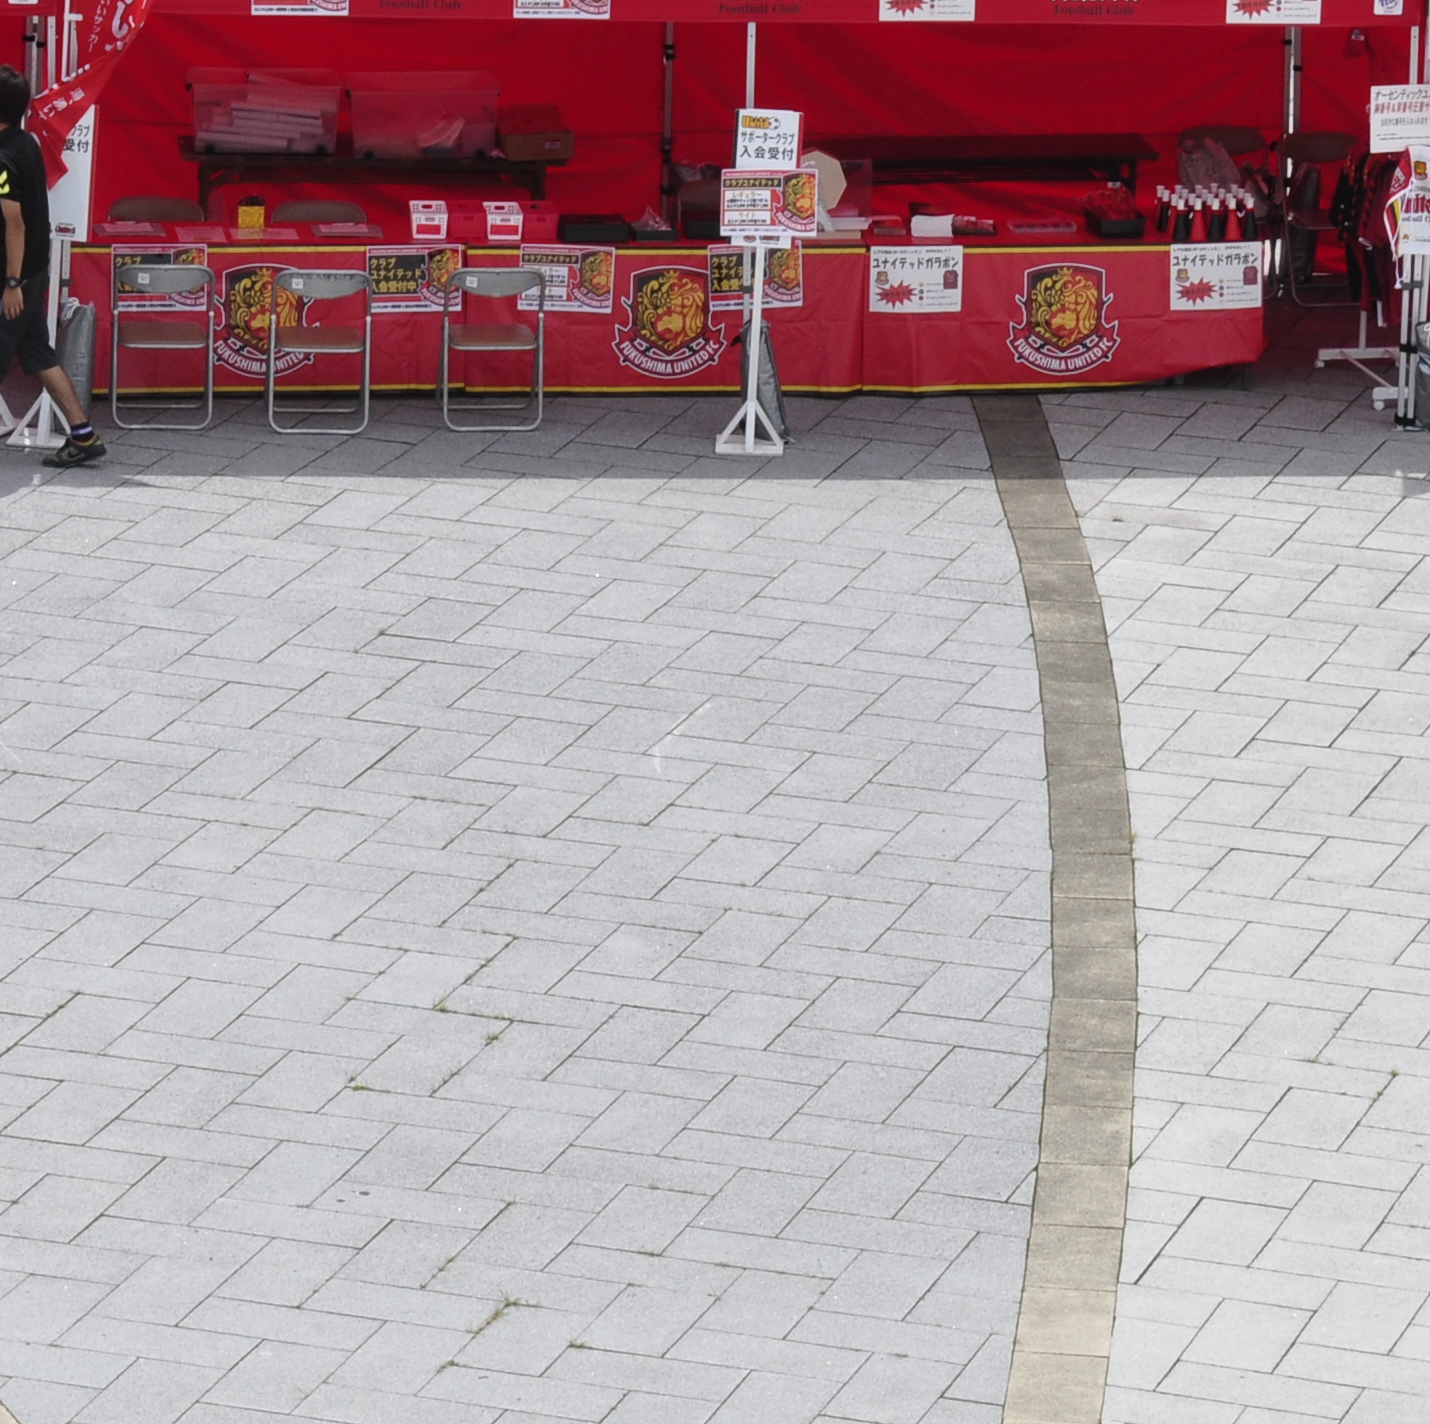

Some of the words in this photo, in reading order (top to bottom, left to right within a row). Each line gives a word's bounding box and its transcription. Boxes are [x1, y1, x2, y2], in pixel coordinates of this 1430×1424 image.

[740, 130, 796, 147] サポータークラブ
[739, 145, 795, 162] 入会受付
[370, 257, 397, 269] クラブ
[711, 256, 738, 267] クラブ
[213, 339, 267, 373] FUKUSHIMA
[272, 352, 305, 372] NITED
[619, 340, 673, 374] FUKUSHIMA
[673, 350, 710, 373] UNITED
[705, 339, 720, 355] FC
[1013, 337, 1067, 371] FUKUSHIMA
[1066, 348, 1103, 370] UNITED
[1099, 336, 1114, 352] FC
